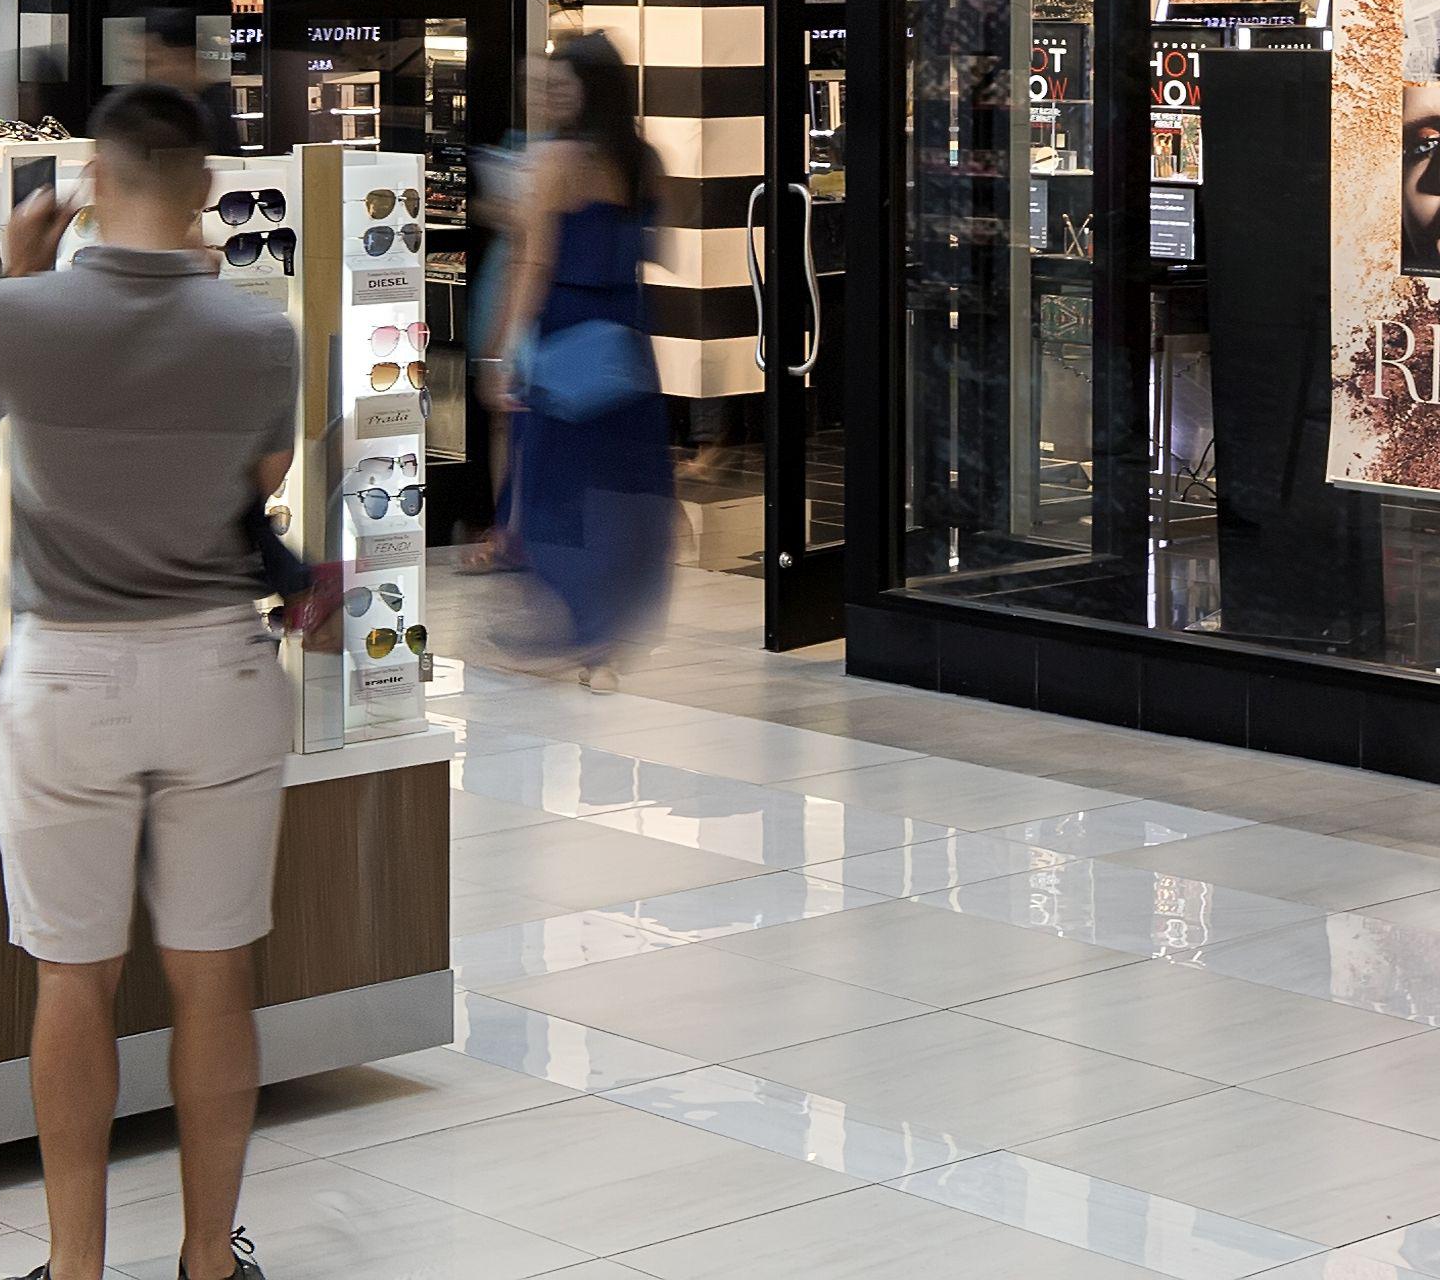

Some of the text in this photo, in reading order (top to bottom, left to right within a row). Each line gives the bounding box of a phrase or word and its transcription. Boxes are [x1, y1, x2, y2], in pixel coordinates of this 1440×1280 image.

[1031, 47, 1067, 73] OT
[1029, 74, 1069, 102] OW
[368, 277, 408, 288] DIESEL
[374, 541, 412, 553] FENDI
